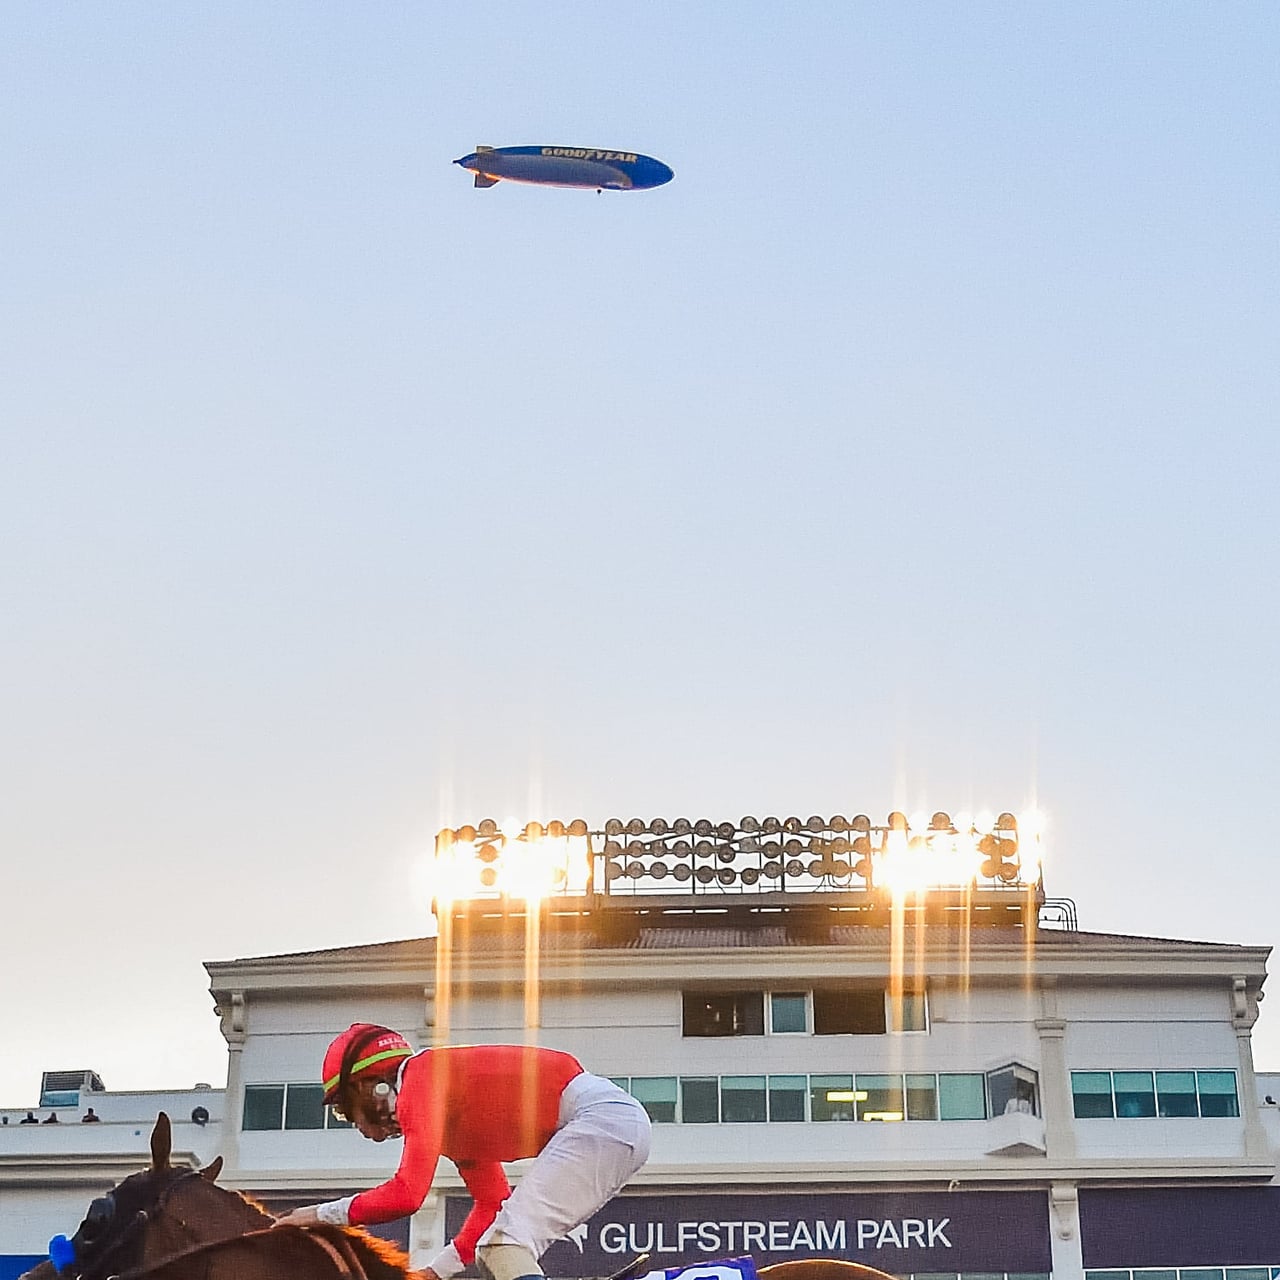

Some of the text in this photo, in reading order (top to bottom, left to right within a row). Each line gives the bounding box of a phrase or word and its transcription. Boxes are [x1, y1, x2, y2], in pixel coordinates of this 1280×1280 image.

[542, 148, 637, 163] GOODYEAR
[600, 1218, 952, 1253] GULFSTREAM PARK
